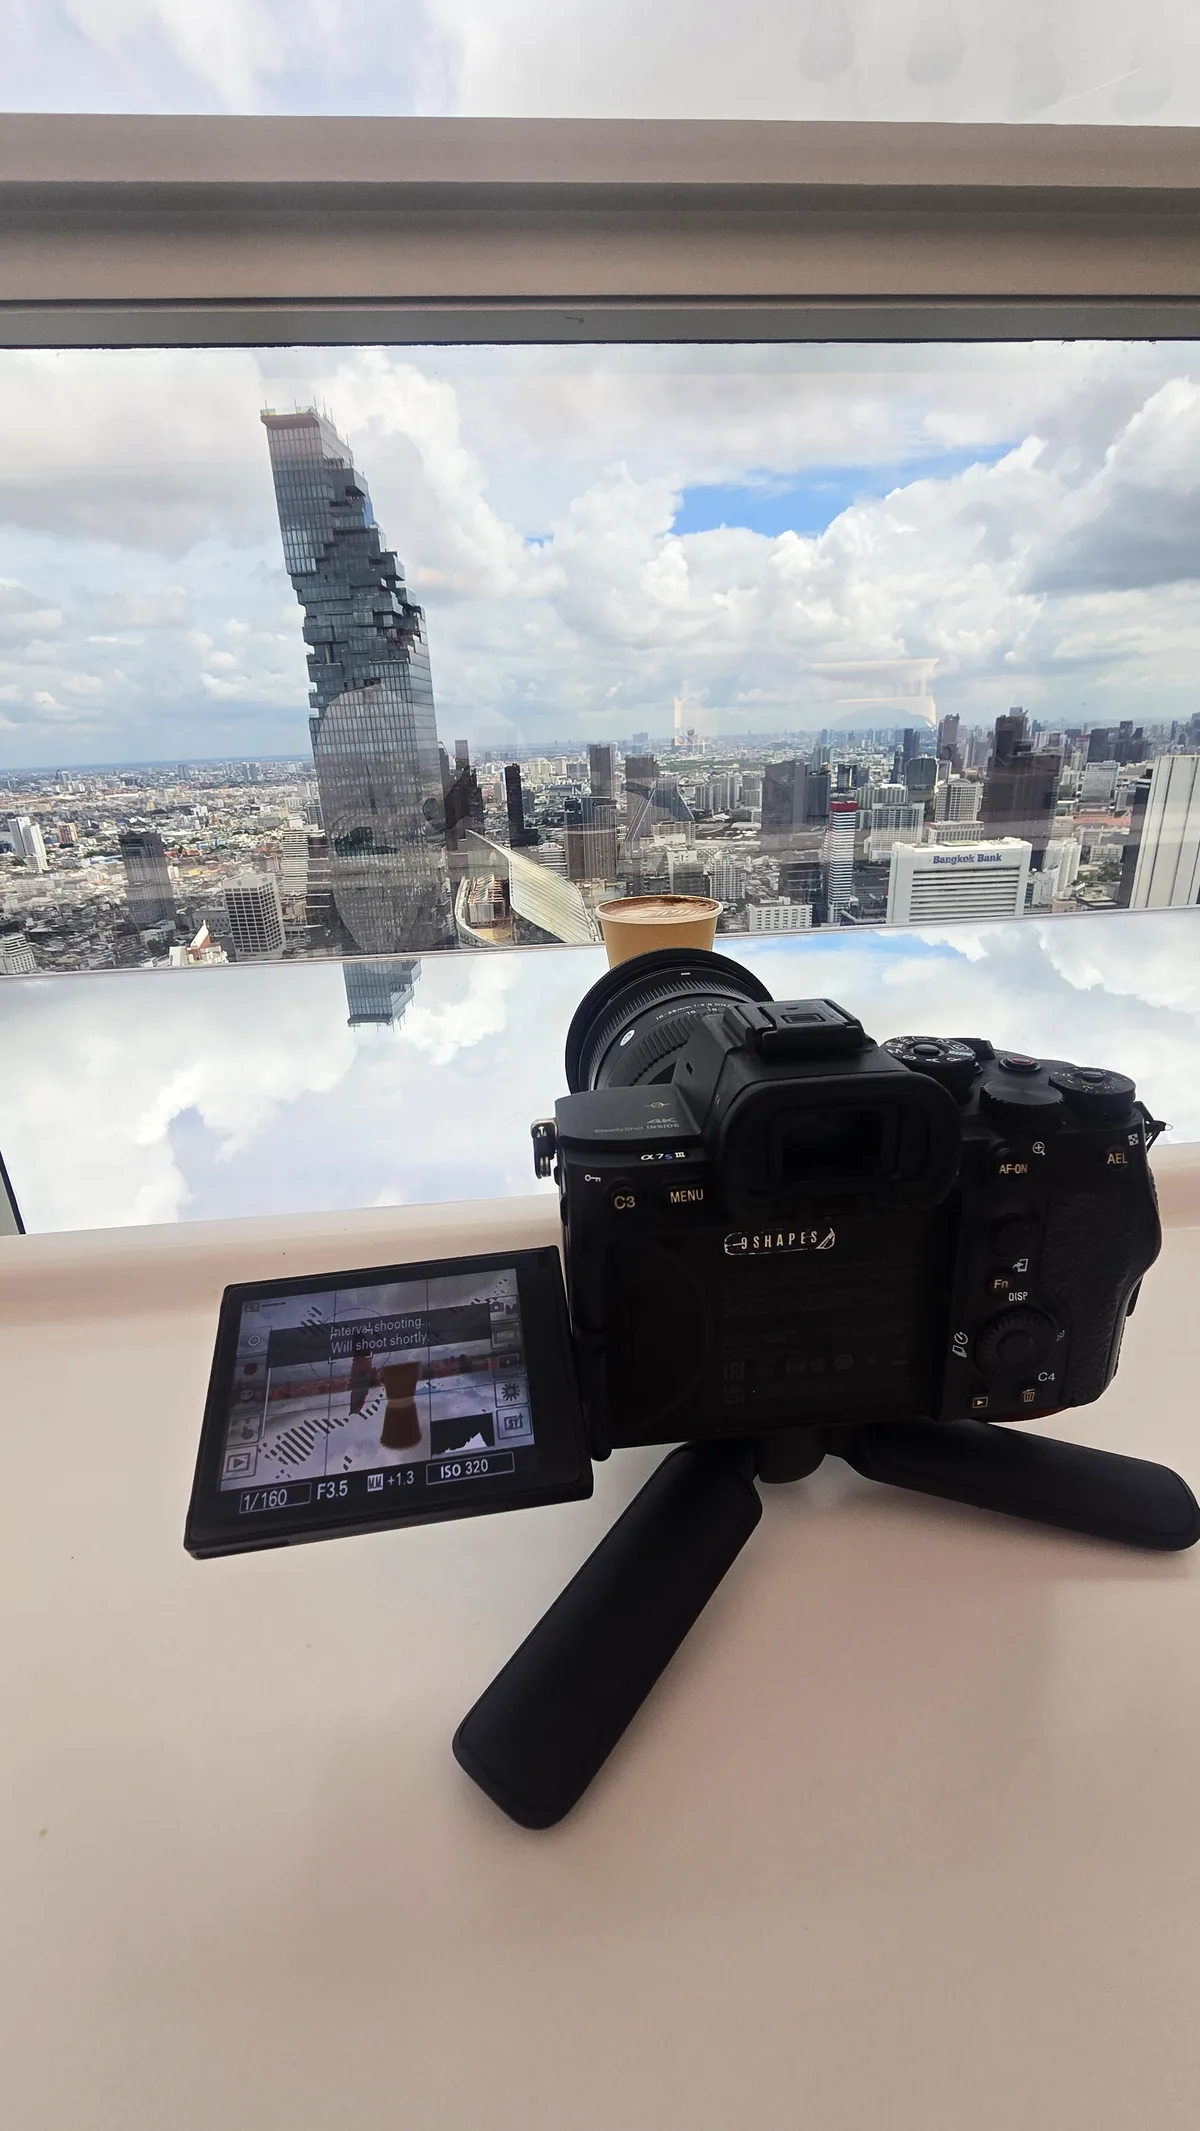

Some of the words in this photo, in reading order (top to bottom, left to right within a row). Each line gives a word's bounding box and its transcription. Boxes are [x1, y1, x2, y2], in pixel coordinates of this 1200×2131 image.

[933, 854, 975, 865] Bangkok
[977, 853, 1002, 862] Bank
[1107, 1153, 1128, 1165] AEL
[999, 1163, 1028, 1174] AF-ON
[614, 1195, 636, 1209] C3
[670, 1188, 704, 1204] MENU
[994, 1279, 1009, 1289] Fn
[1008, 1291, 1028, 1302] DISP
[331, 1339, 353, 1354] Will
[355, 1337, 387, 1351] shoot
[389, 1331, 430, 1346] shortly.
[1038, 1372, 1055, 1382] C4
[440, 1464, 461, 1479] ISO
[465, 1459, 489, 1475] 320
[387, 1470, 415, 1487] +1.3
[317, 1480, 348, 1500] F3.5
[243, 1488, 288, 1511] 1/160
